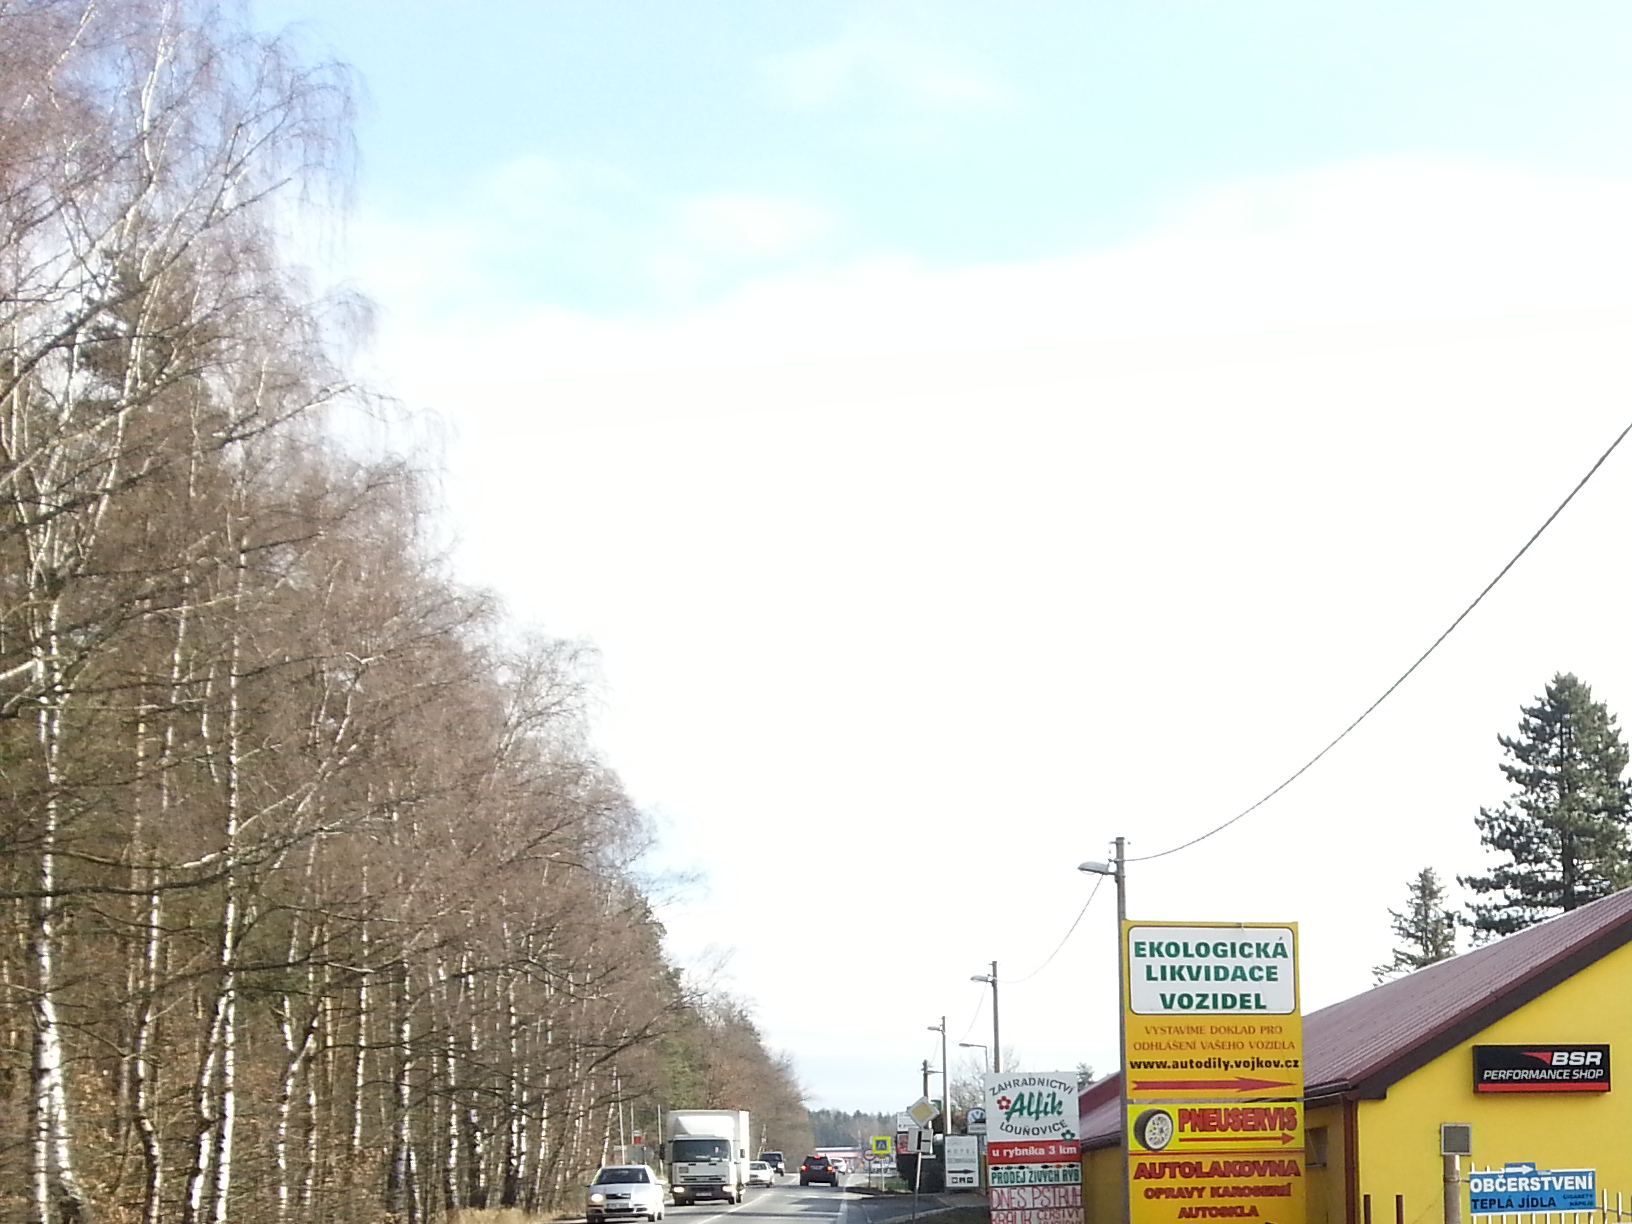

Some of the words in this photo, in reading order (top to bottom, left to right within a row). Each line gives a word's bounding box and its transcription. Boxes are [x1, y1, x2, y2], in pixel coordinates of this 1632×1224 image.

[1133, 936, 1289, 959] EKOLOGICKÁ
[1145, 964, 1279, 982] LIKVIDACE
[1159, 992, 1267, 1010] VOZIDEL
[1209, 1025, 1256, 1035] DOKLAD
[1260, 1025, 1283, 1035] PRO
[1200, 1038, 1245, 1050] VAŠEHO
[1249, 1041, 1295, 1050] VOZIDLA
[1551, 1051, 1602, 1066] BSR
[1483, 1069, 1570, 1080] PERFORMANCE
[1571, 1069, 1604, 1079] SHOP
[1177, 1106, 1298, 1132] PNEUSERVIS
[992, 1149, 999, 1157] u
[1049, 1145, 1056, 1155] 3
[1060, 1145, 1077, 1155] km
[991, 1170, 1026, 1184] PRODEJ
[1062, 1168, 1080, 1182] RYB
[1133, 1160, 1302, 1180] AUTOLAKOVNA
[1470, 1171, 1594, 1193] OBČERSTVENÍ
[1143, 1186, 1206, 1200] OPRAVY
[1471, 1194, 1514, 1209] TEPLÁ
[1518, 1194, 1556, 1208] JÍDLA
[1178, 1205, 1259, 1219] AUTOSKLA
